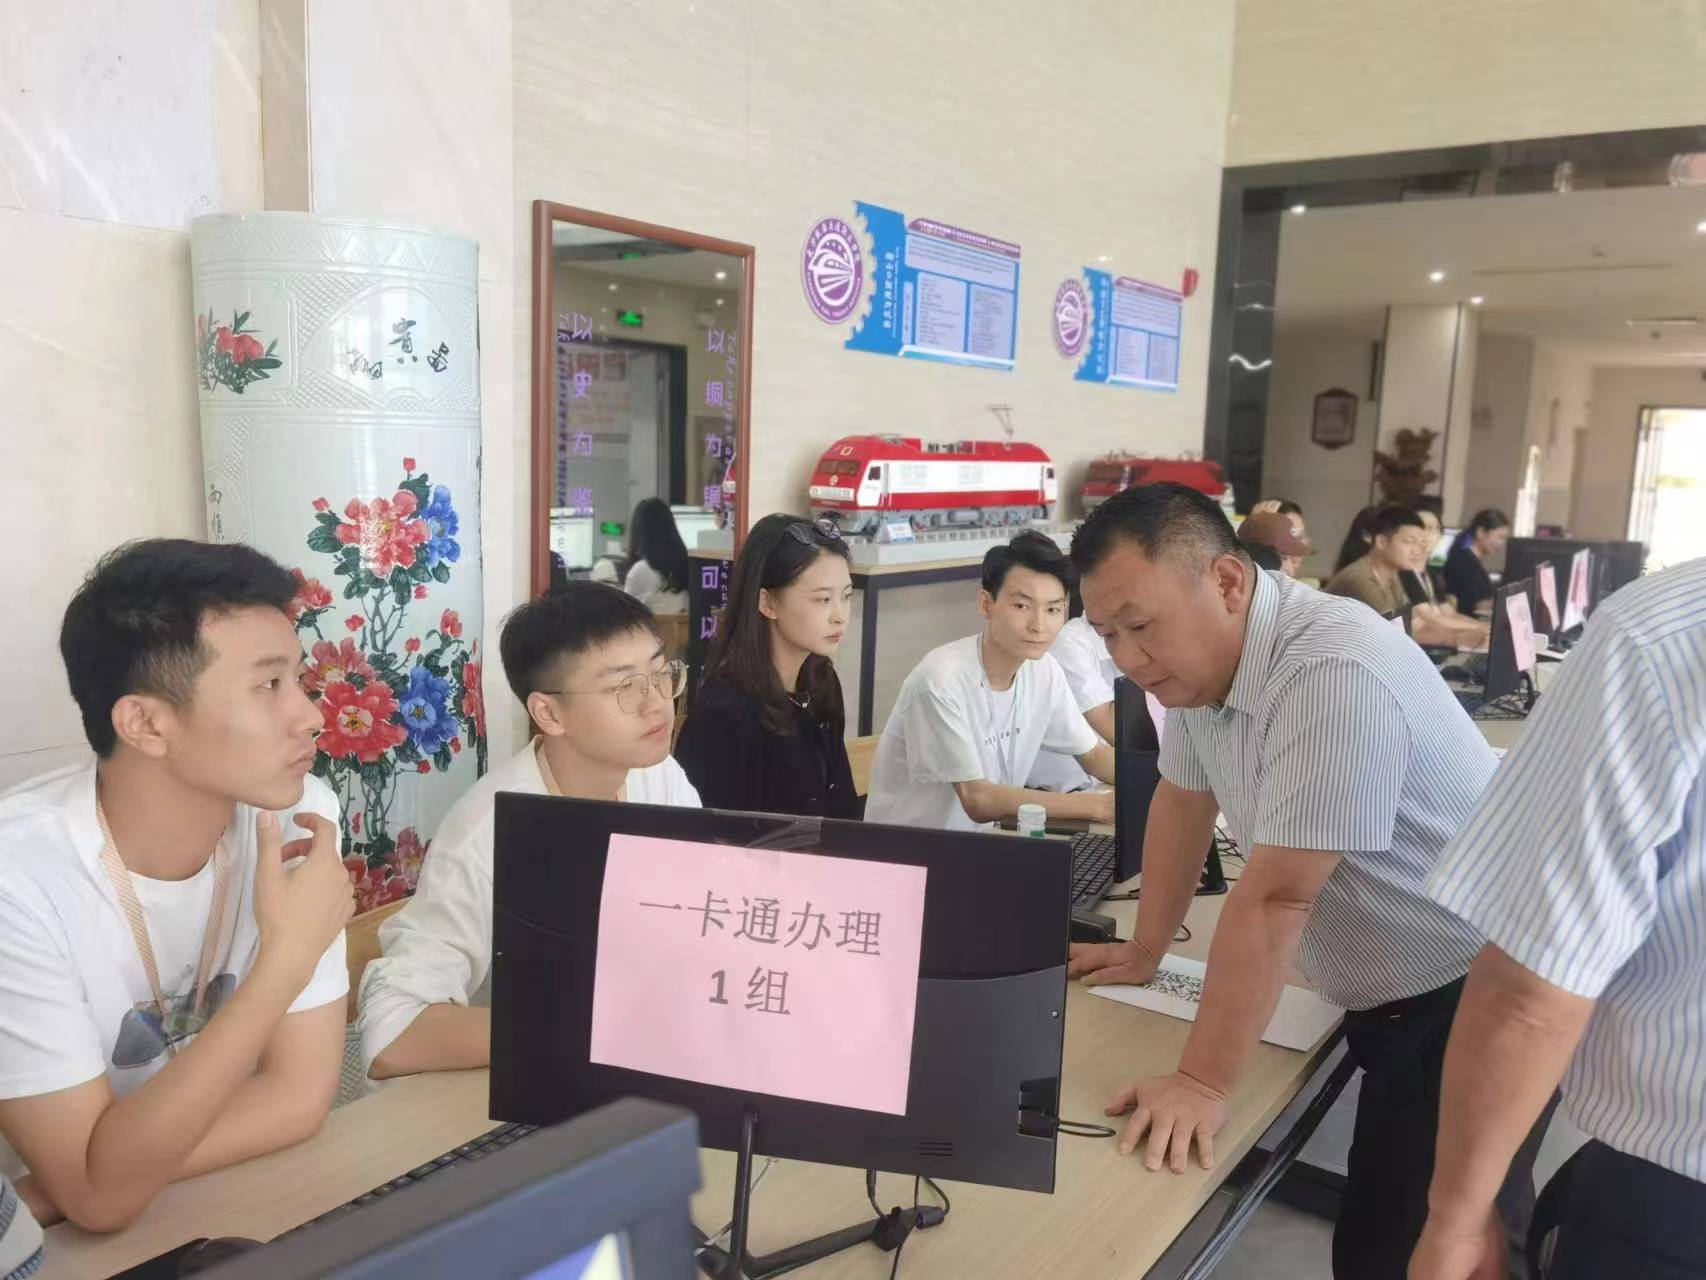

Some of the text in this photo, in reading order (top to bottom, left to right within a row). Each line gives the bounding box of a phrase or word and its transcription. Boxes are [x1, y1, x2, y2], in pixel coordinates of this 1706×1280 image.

[639, 889, 882, 957] 一卡通办理
[708, 966, 792, 1016] 1 组
